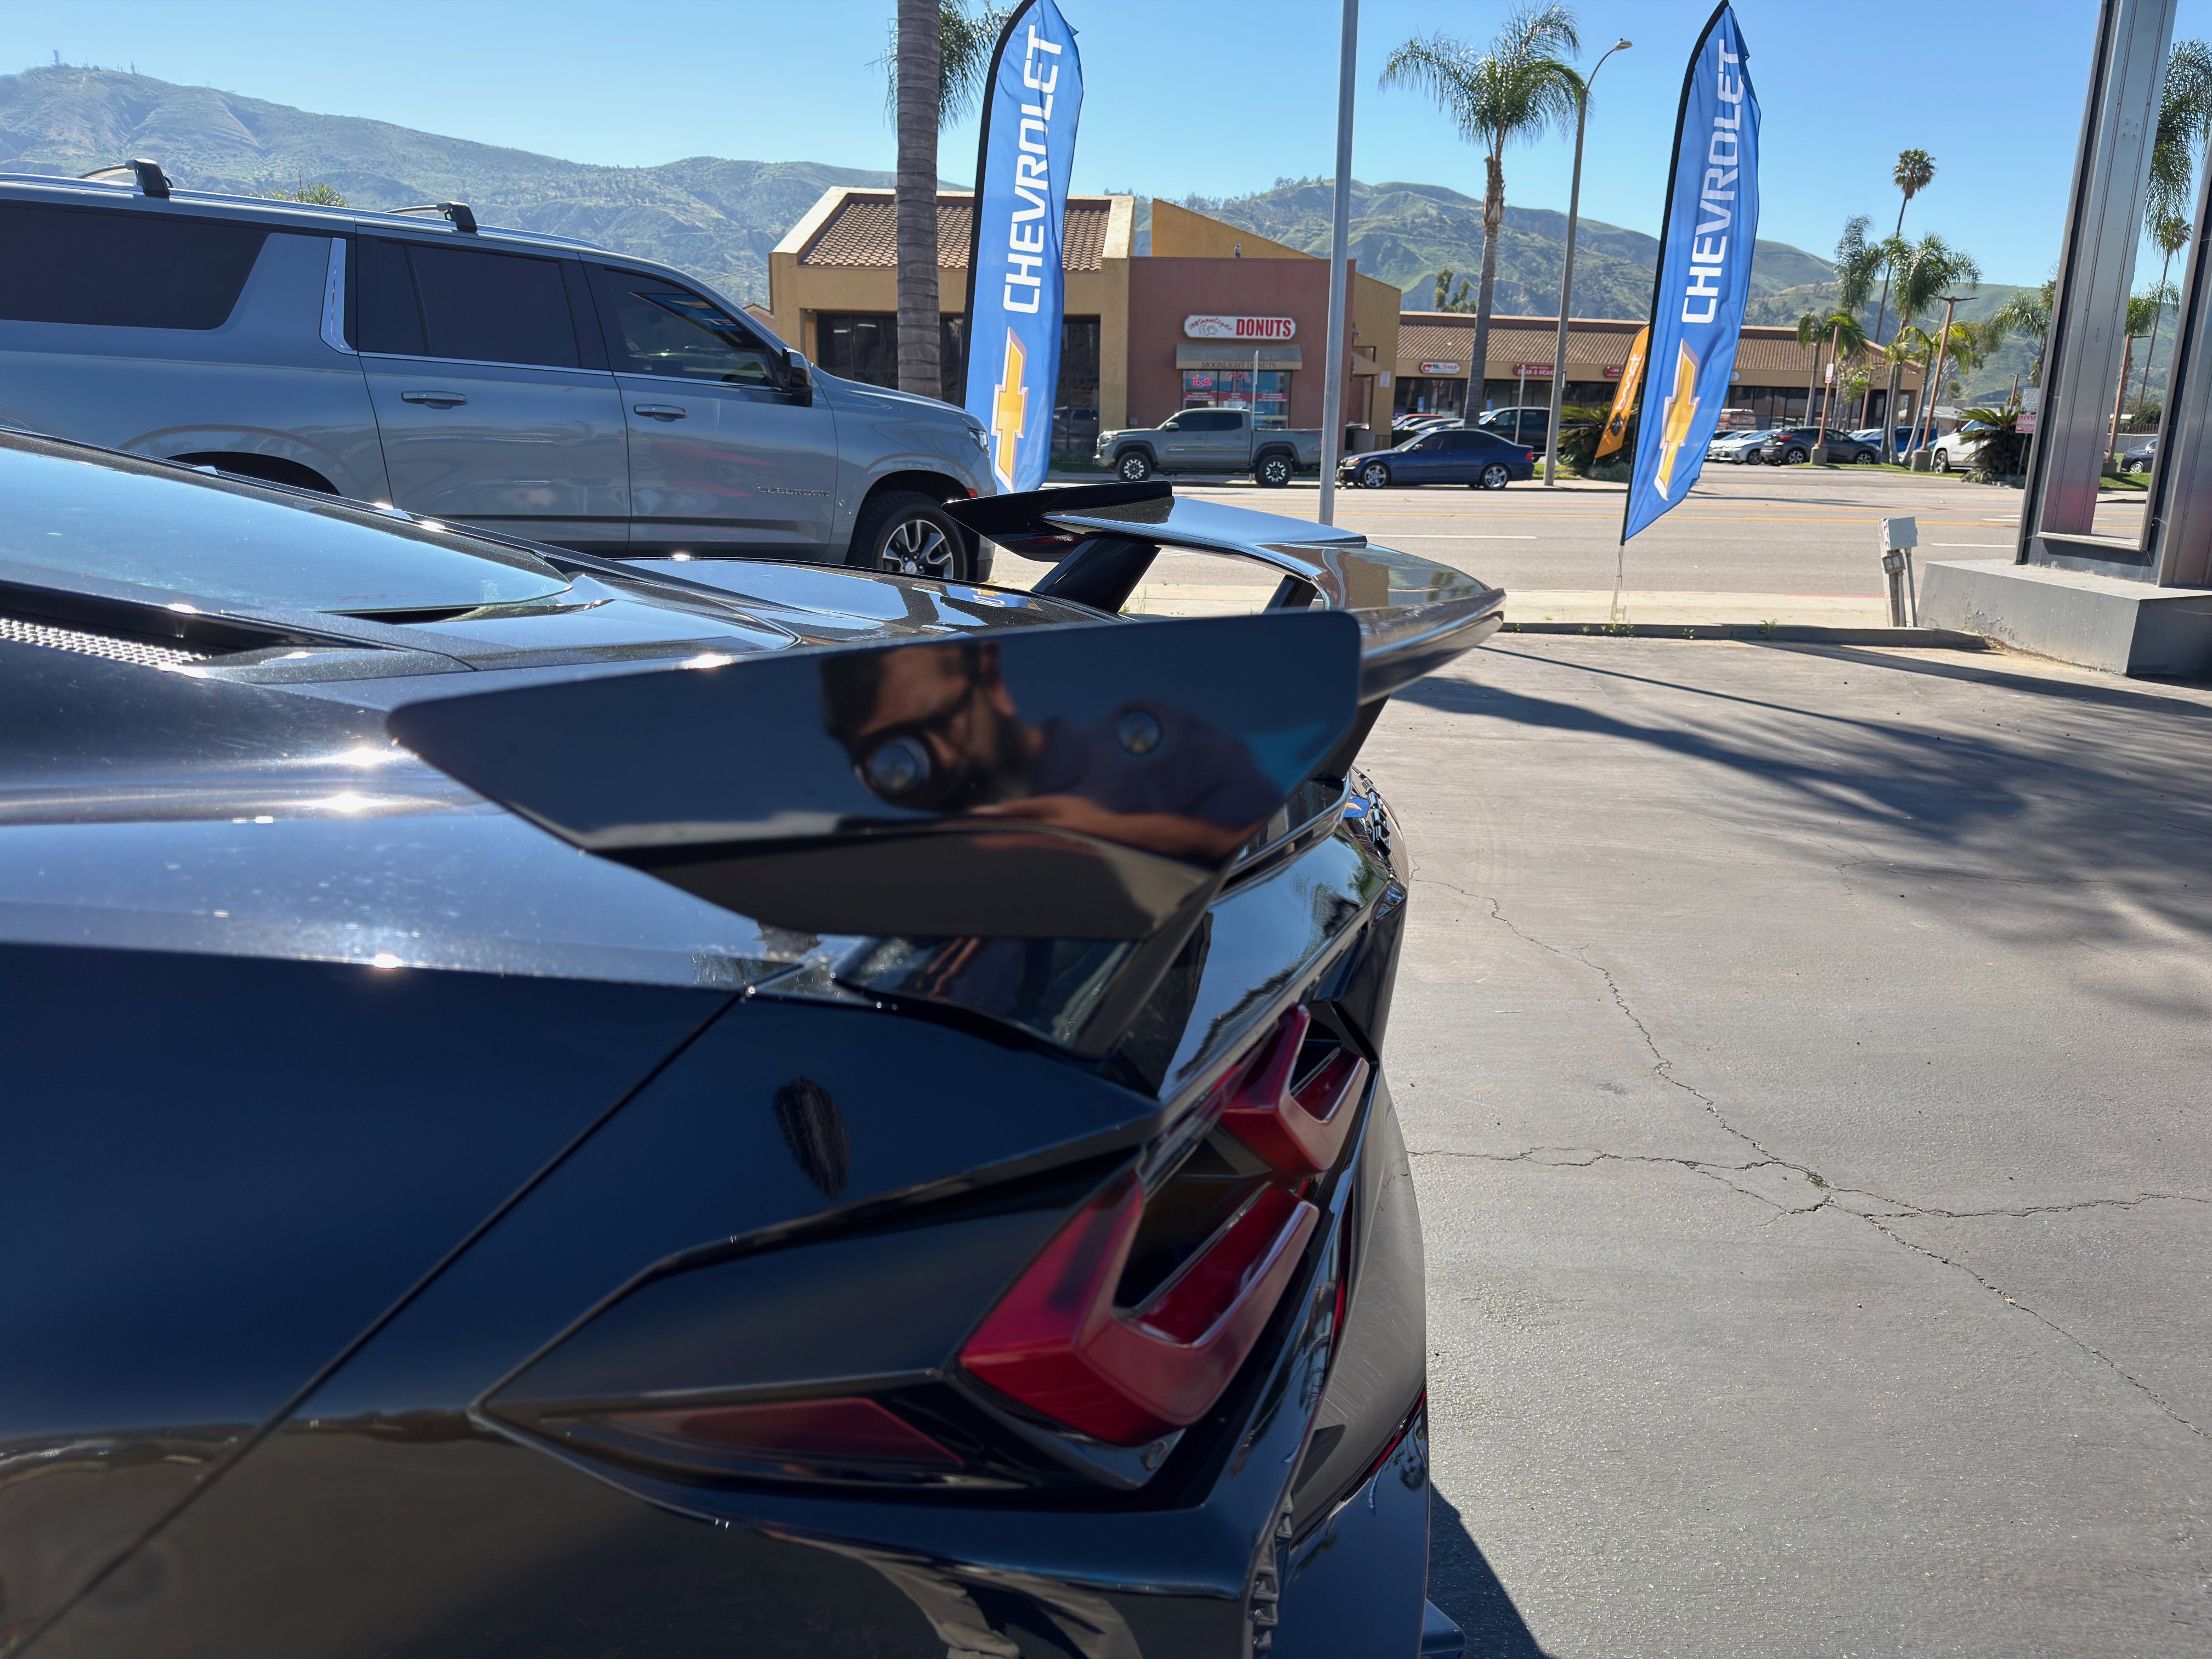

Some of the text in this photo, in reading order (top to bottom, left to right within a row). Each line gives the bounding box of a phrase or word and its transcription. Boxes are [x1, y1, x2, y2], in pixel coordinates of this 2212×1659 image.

[1003, 25, 1062, 314] CHEVROLET
[1681, 39, 1745, 323] CHEVROLET
[1236, 318, 1291, 337] DONUTS
